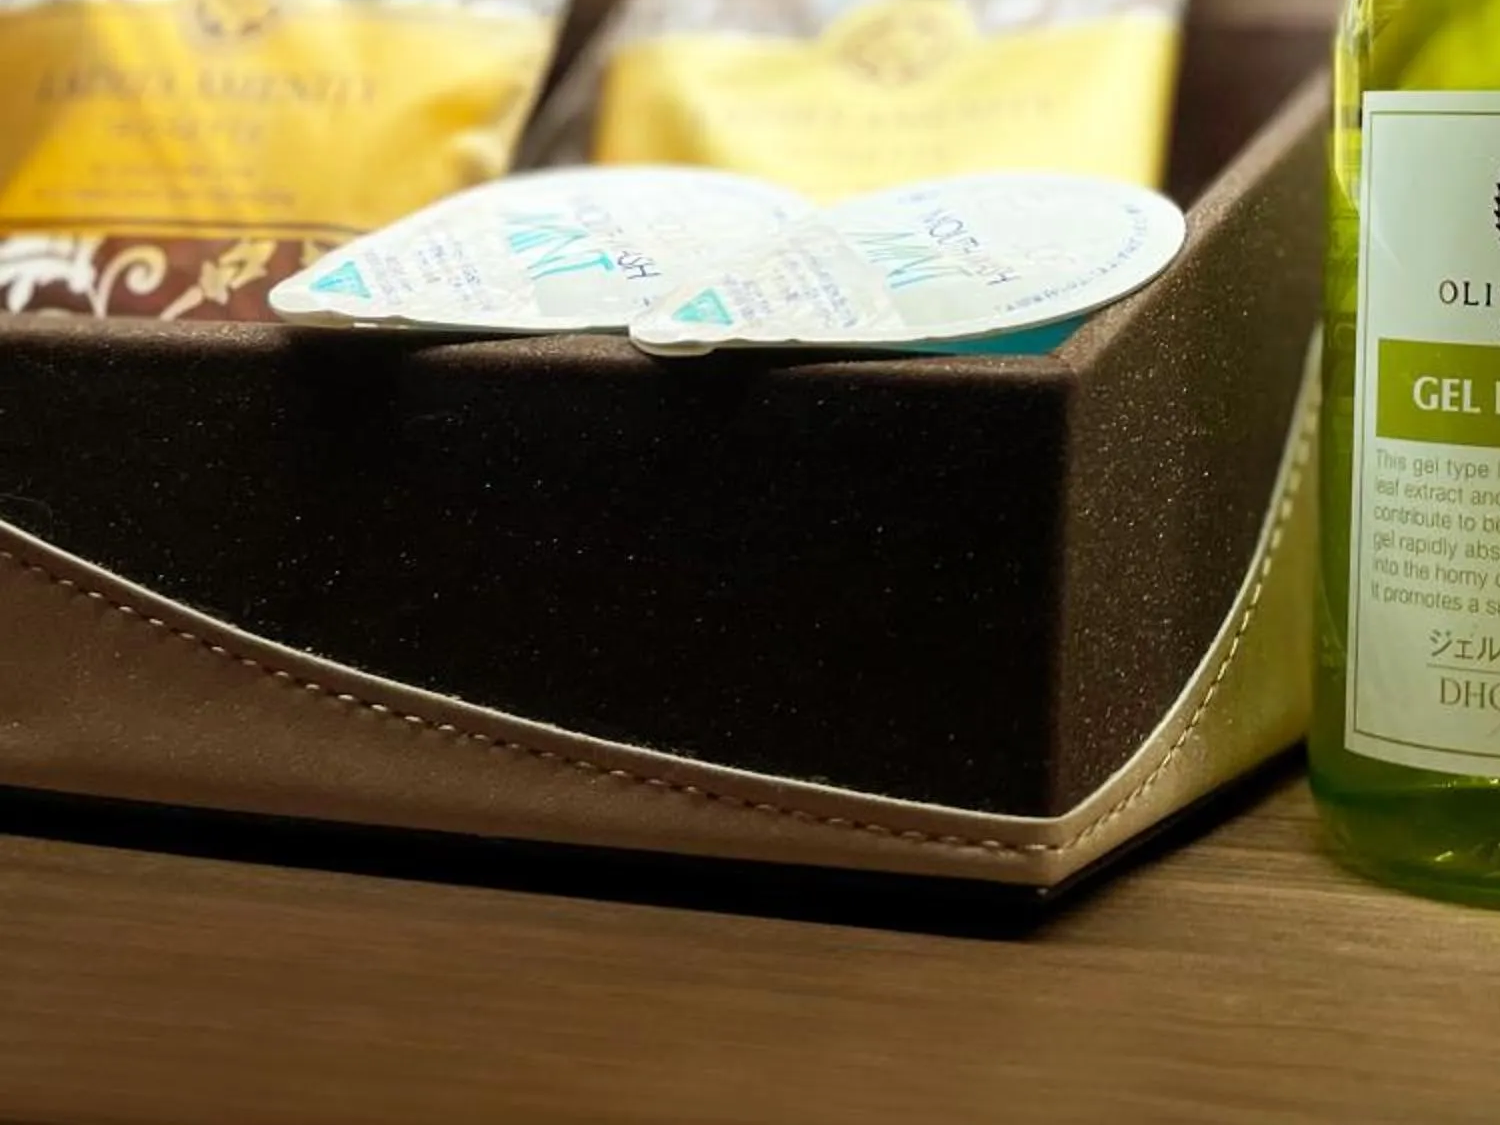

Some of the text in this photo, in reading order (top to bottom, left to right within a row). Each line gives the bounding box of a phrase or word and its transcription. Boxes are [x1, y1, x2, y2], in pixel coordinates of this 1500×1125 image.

[1413, 376, 1480, 414] GEL
[1376, 449, 1406, 472] This
[1413, 456, 1439, 477] gel
[1447, 460, 1489, 480] type
[1405, 482, 1463, 503] extract
[1459, 513, 1476, 531] to
[1373, 530, 1395, 551] gel
[1400, 535, 1457, 559] rapidly
[1405, 561, 1429, 579] the
[1384, 587, 1462, 612] promotes
[1468, 599, 1479, 614] a
